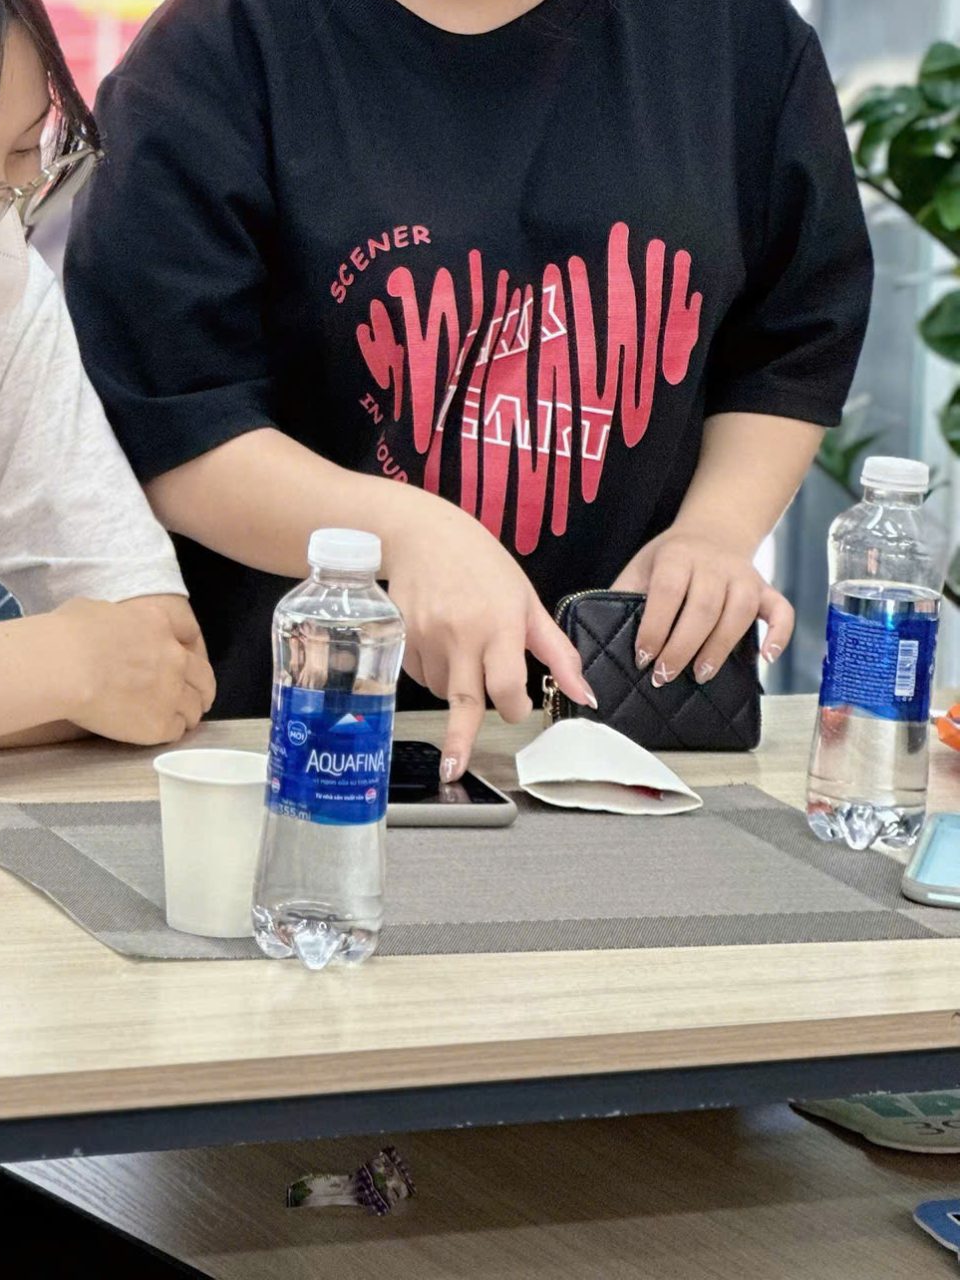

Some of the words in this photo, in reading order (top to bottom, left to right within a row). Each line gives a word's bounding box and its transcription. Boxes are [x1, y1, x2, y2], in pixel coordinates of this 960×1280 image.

[331, 225, 431, 304] SCENER
[359, 393, 384, 425] IN
[305, 749, 386, 776] AQUAFINA
